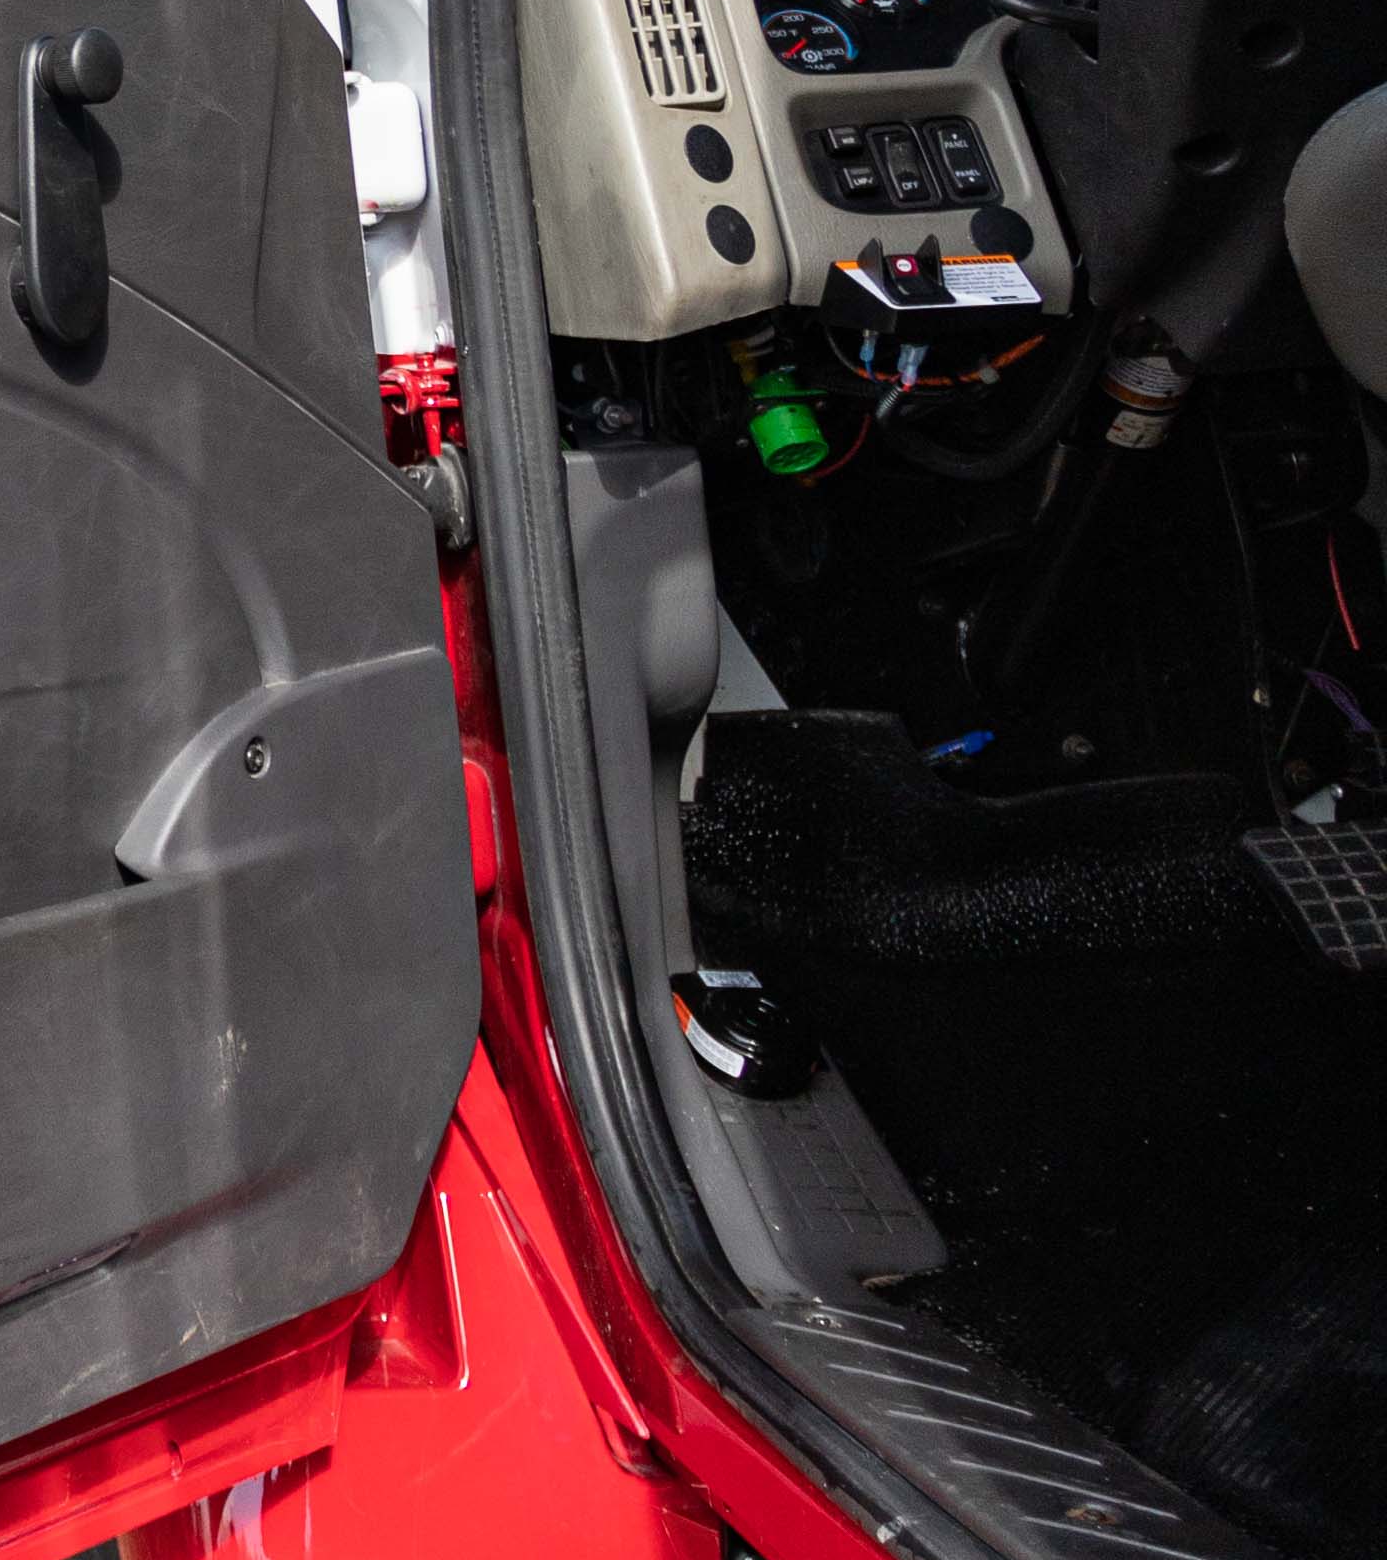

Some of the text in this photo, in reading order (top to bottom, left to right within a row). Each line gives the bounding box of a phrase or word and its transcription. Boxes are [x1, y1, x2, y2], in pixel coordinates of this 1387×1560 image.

[782, 14, 806, 23] 200
[766, 30, 787, 38] 150
[811, 26, 834, 35] 250
[822, 48, 845, 56] 300
[944, 140, 969, 149] PANEL
[955, 169, 981, 177] PANEL
[902, 181, 919, 191] OFF
